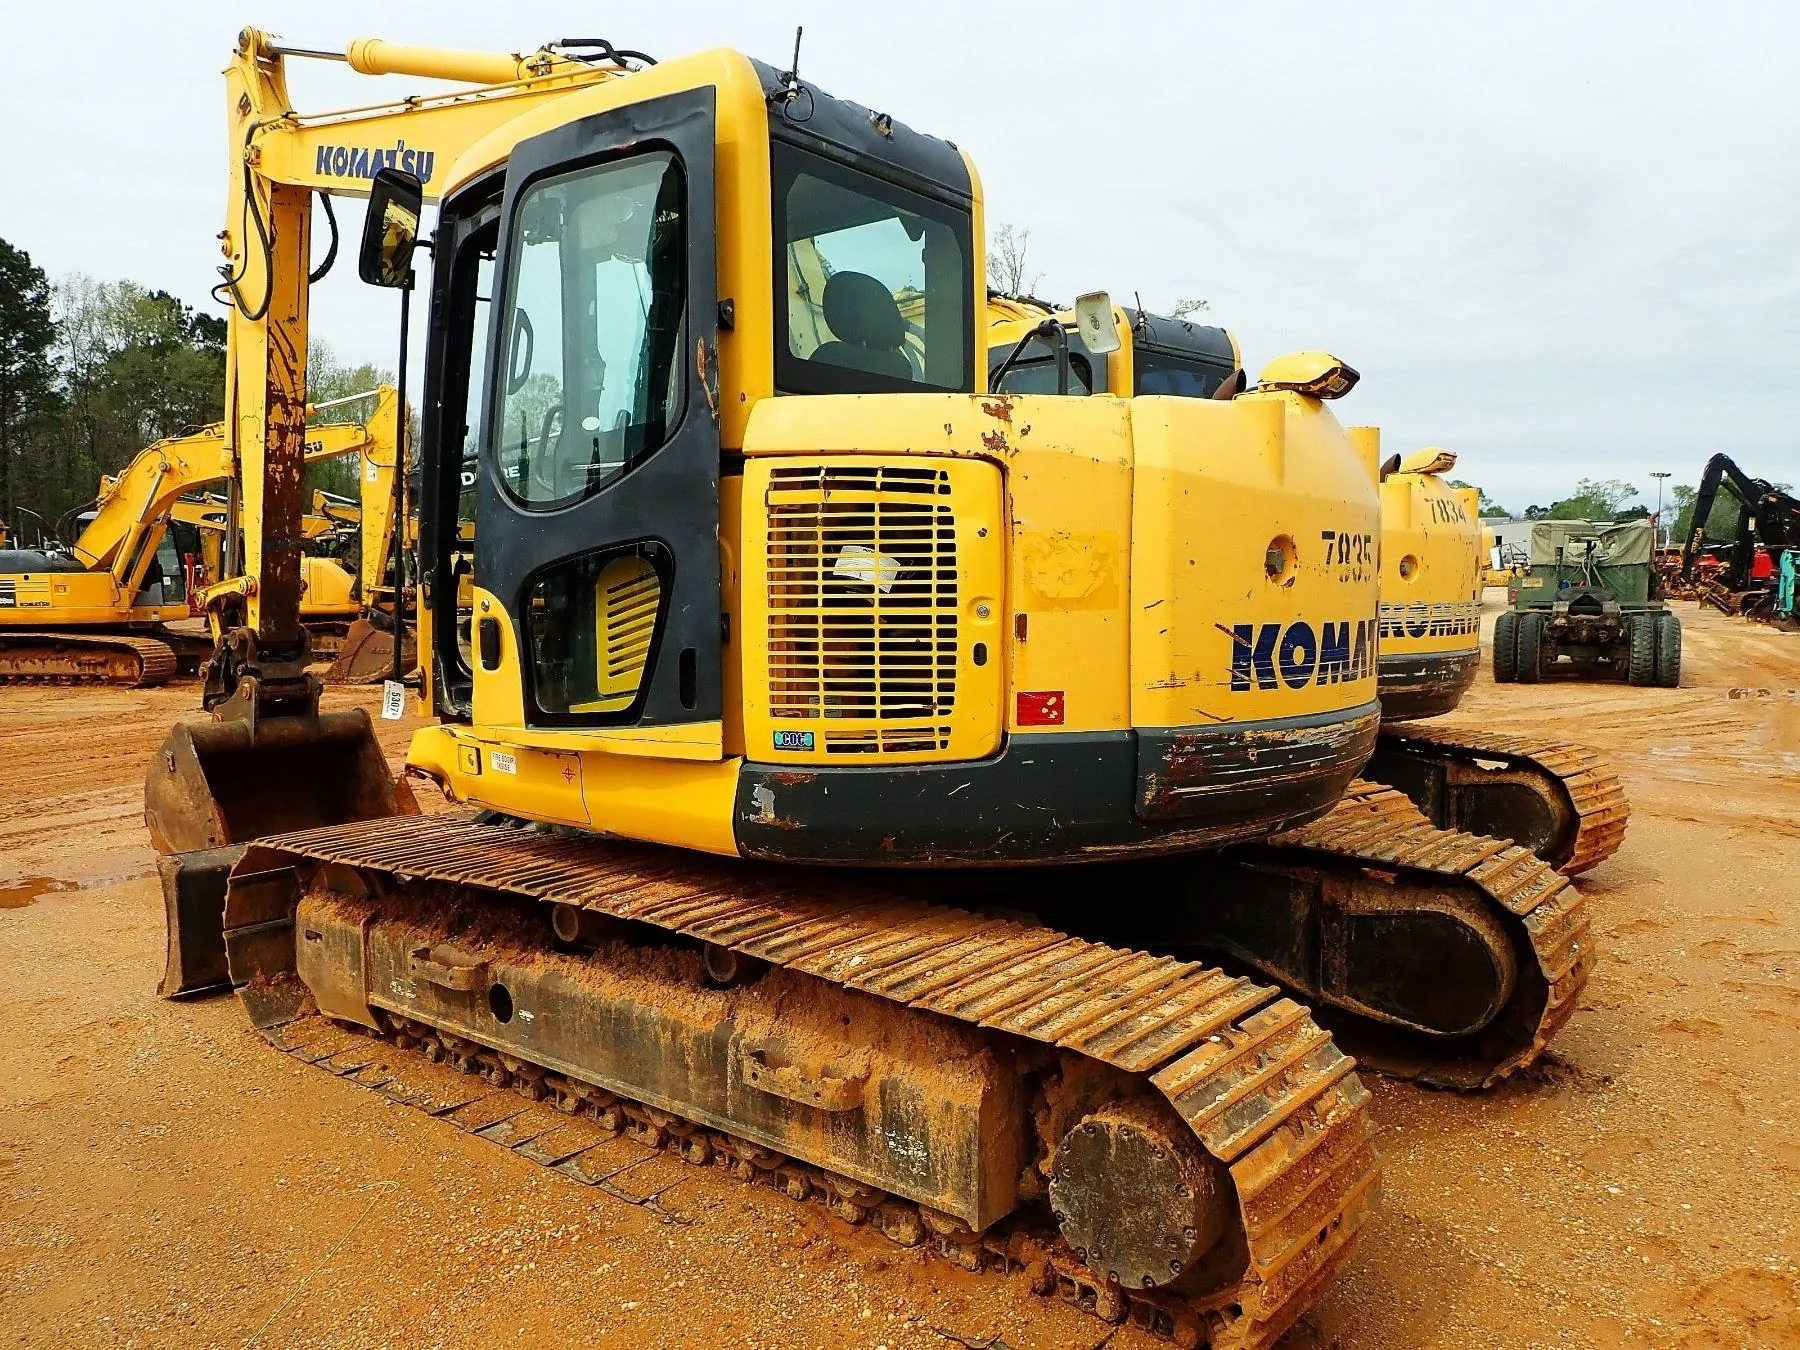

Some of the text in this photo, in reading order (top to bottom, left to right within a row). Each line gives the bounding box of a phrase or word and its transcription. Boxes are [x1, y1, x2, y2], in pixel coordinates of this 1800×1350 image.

[315, 140, 435, 185] KOMATSU
[1424, 498, 1467, 525] 7834
[390, 691, 402, 713] 5307
